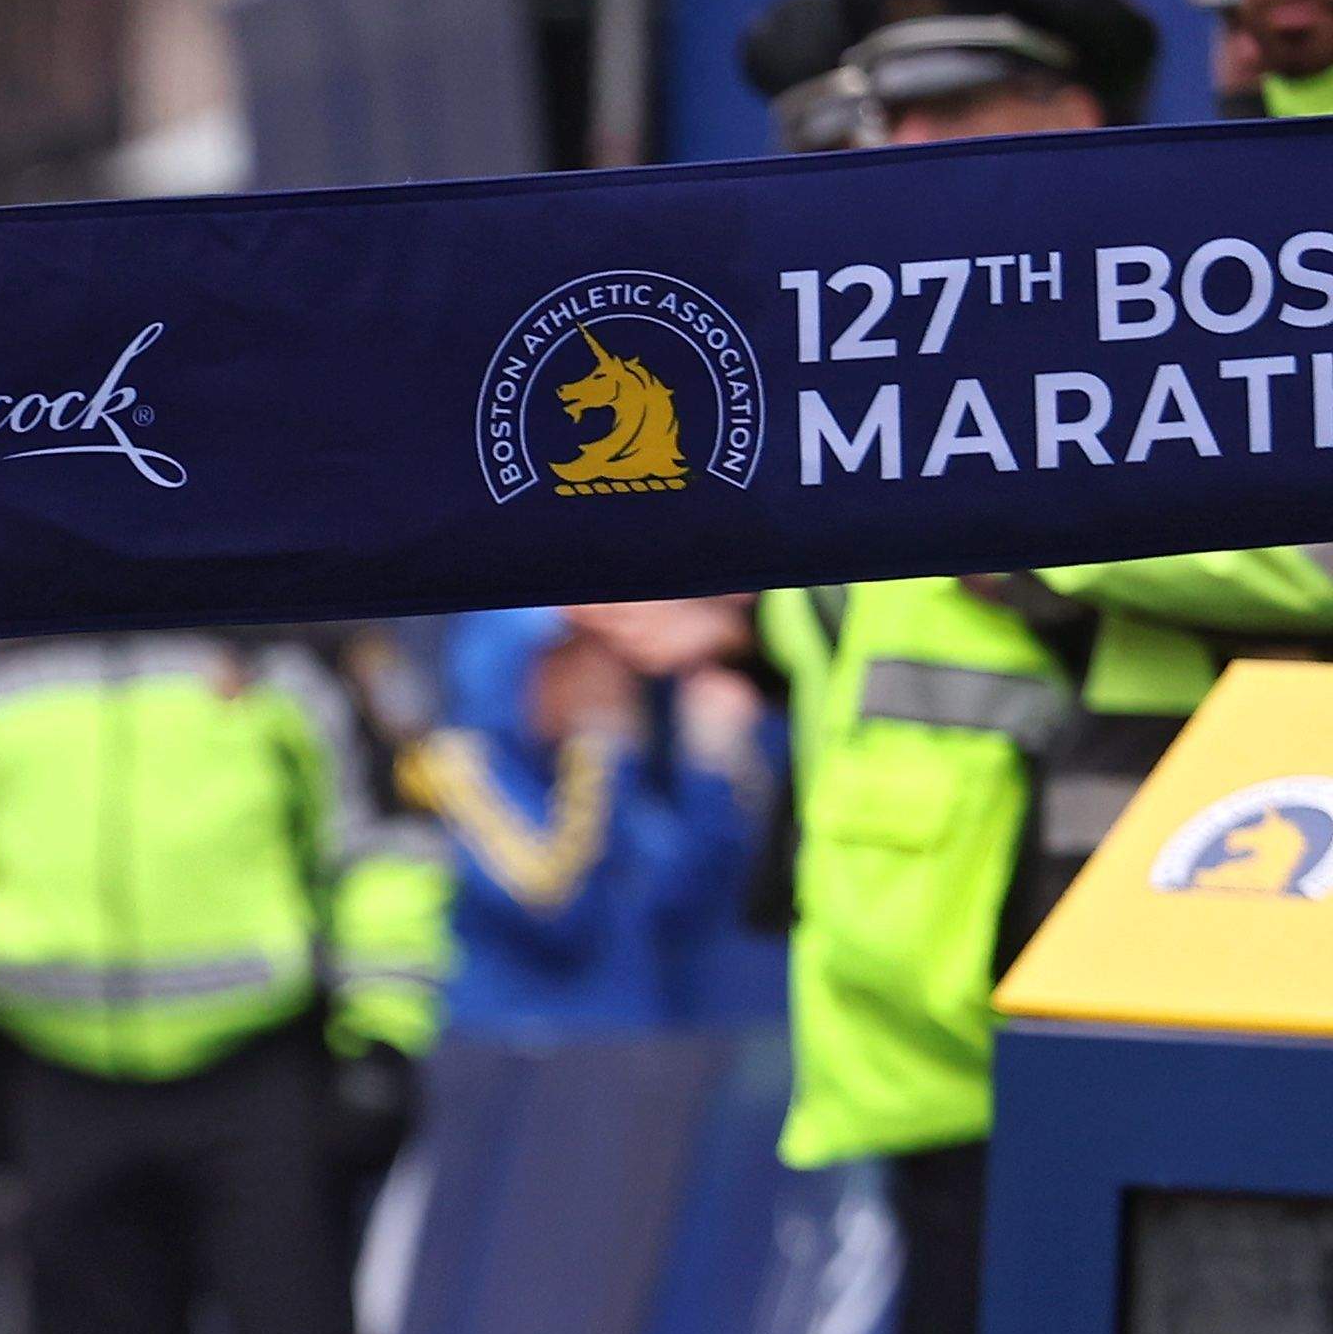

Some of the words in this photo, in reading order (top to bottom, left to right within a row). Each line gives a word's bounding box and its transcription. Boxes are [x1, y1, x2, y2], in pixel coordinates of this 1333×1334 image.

[780, 251, 1063, 364] 127TH
[1094, 231, 1333, 343] BOS
[491, 356, 527, 486] BOSTON
[523, 284, 653, 355] ATHLETIC
[657, 292, 752, 473] ASSOCIATION
[798, 352, 1333, 486] MARAT
